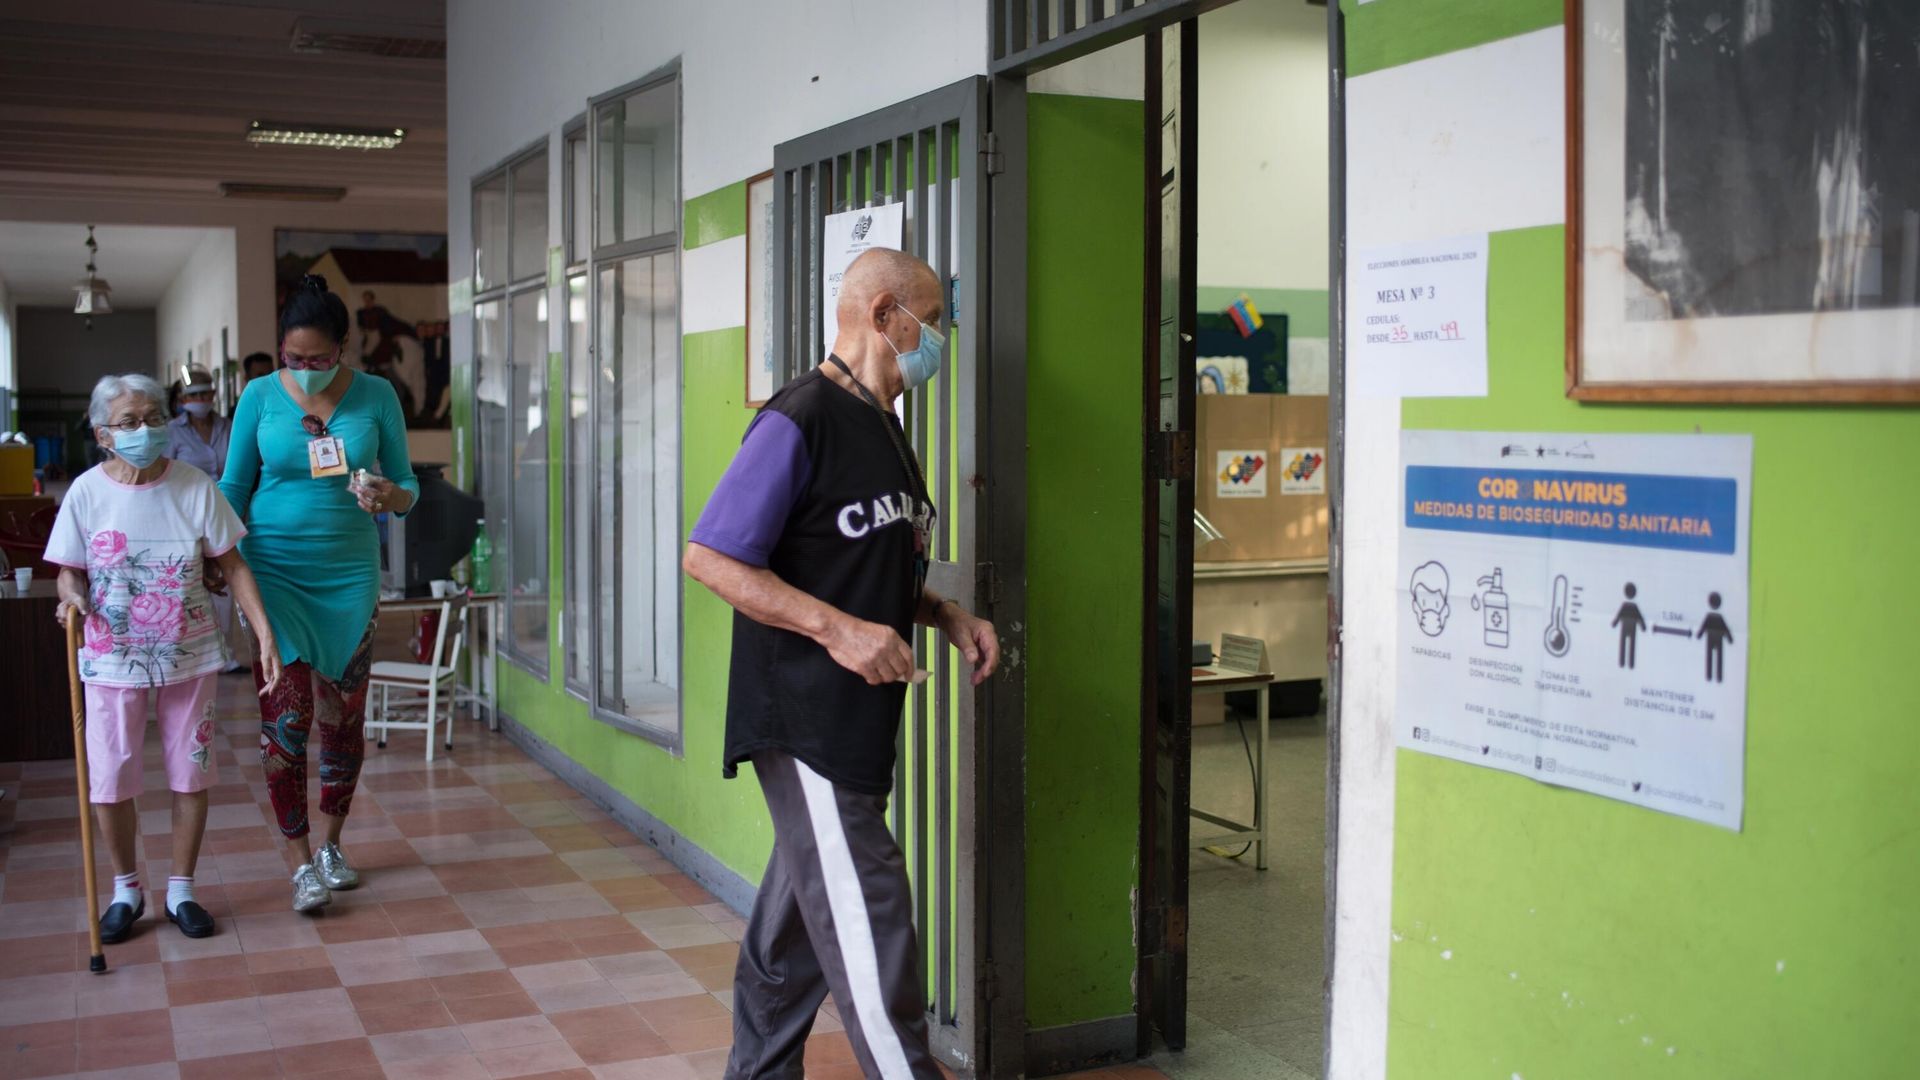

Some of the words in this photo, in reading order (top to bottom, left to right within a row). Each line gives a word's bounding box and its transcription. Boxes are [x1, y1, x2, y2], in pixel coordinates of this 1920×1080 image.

[1377, 288, 1405, 304] MESA
[1428, 286, 1435, 299] 3
[1367, 333, 1390, 343] DESDE
[1391, 325, 1409, 340] 35
[1414, 331, 1438, 341] HASTA
[1414, 501, 1473, 518] MEDIDAS
[1477, 504, 1495, 519] DE
[1499, 506, 1614, 528] BIOSEGURIDAD
[1618, 512, 1712, 537] SANITARIA
[1411, 646, 1451, 660] TAPABOCAS
[1470, 668, 1485, 678] CON
[1487, 673, 1522, 686] ALCOHOL
[1541, 670, 1566, 681] TOMA
[1641, 687, 1695, 704] MANTENER
[1624, 696, 1676, 713] DISTANCIA
[1678, 706, 1691, 717] DE
[1563, 724, 1584, 736] ESTA
